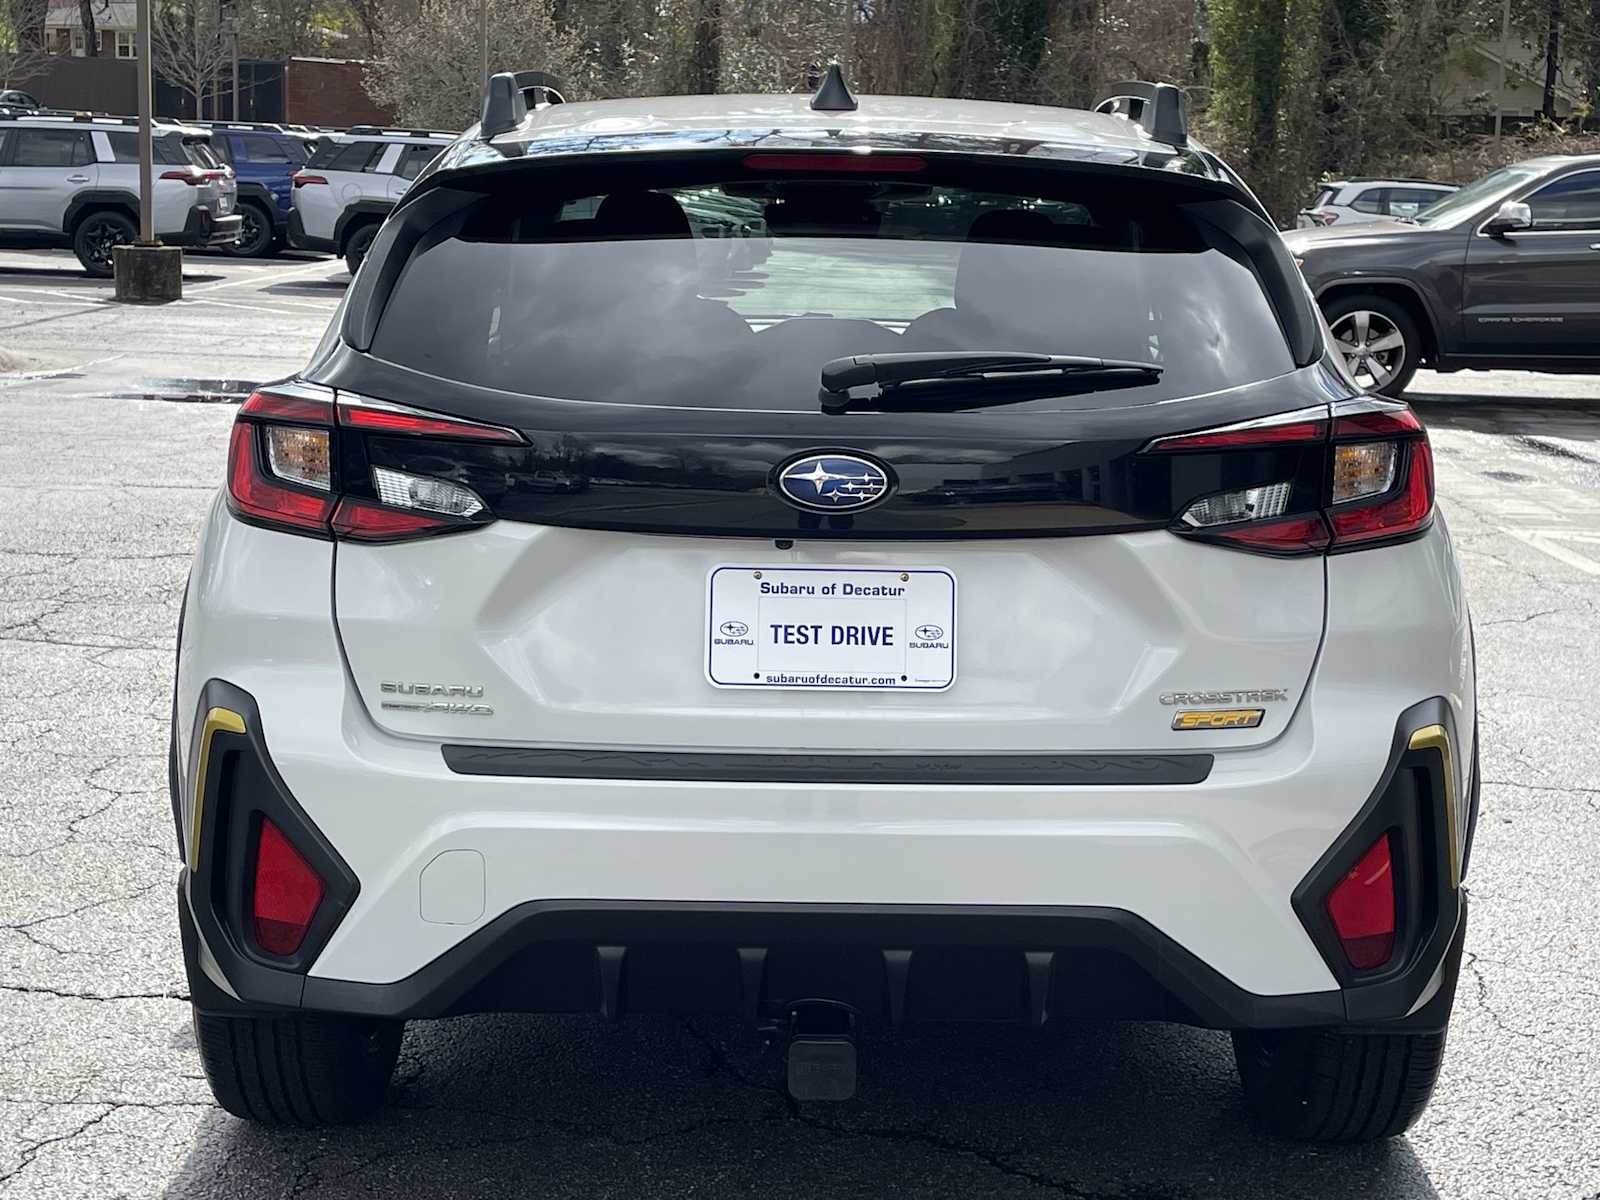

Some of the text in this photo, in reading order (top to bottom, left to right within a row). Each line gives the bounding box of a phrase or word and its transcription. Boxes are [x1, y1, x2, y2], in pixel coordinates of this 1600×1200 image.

[760, 582, 906, 597] Subaru of Decatur
[770, 624, 894, 646] TEST DRIVE
[766, 673, 896, 685] subaruofdecatur.com
[380, 681, 484, 698] SUBARU
[1160, 688, 1288, 706] CROSSTREK
[1181, 711, 1260, 726] SPORT
